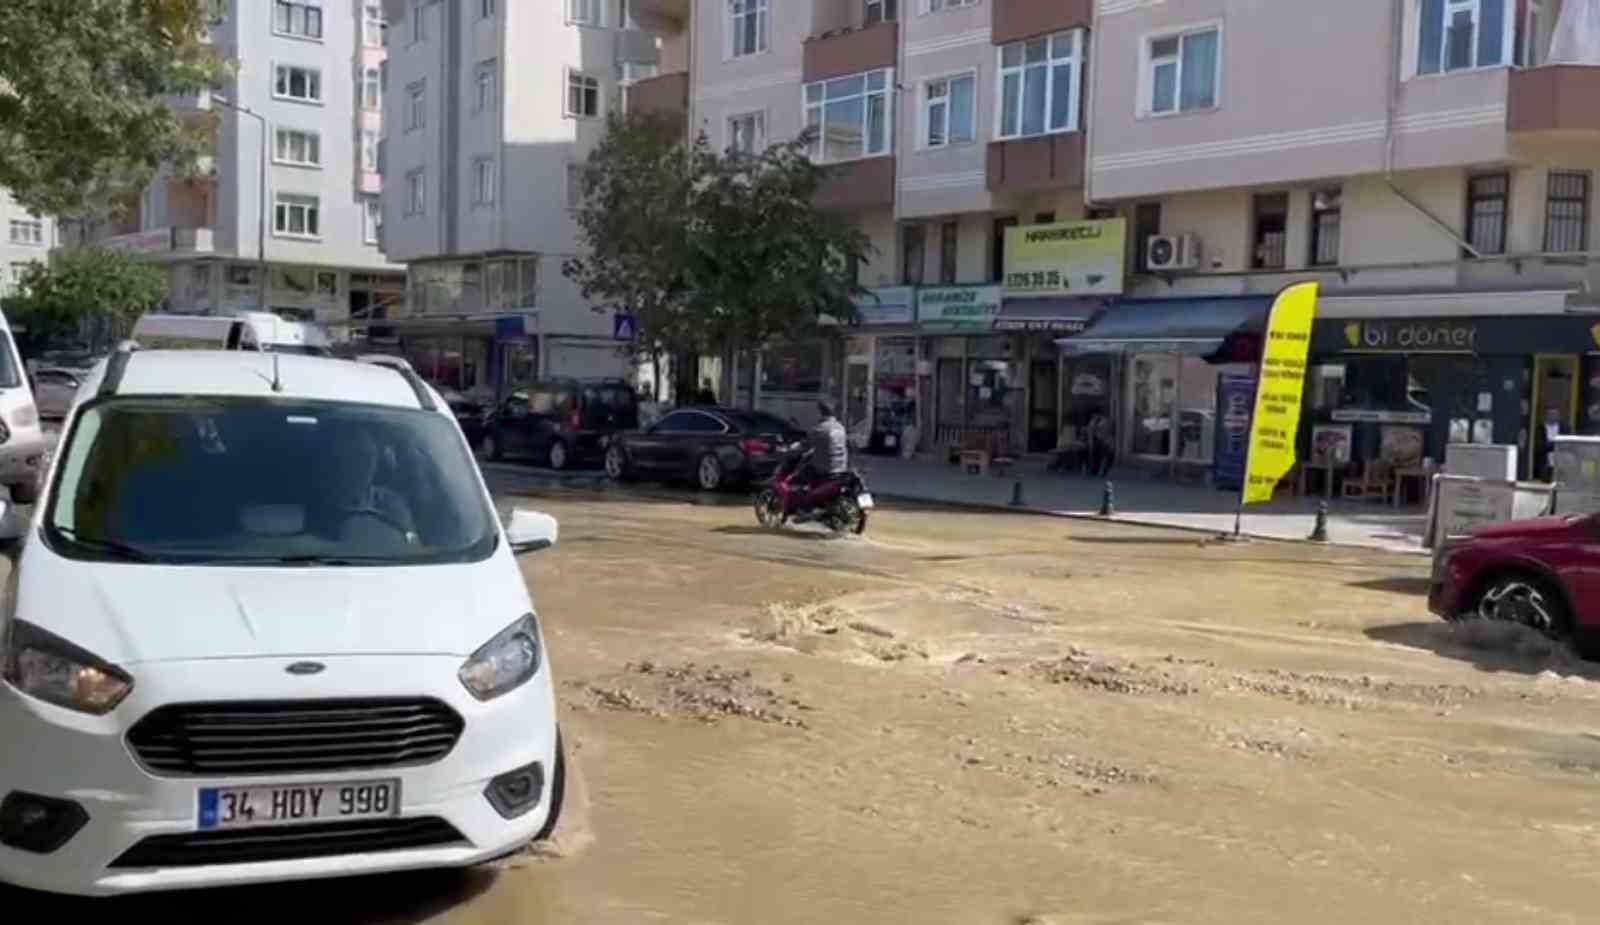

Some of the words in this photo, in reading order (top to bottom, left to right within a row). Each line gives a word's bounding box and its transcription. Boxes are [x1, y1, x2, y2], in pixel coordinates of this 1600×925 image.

[1363, 319, 1387, 346] bi
[221, 792, 255, 822] 34
[339, 784, 391, 816] 998
